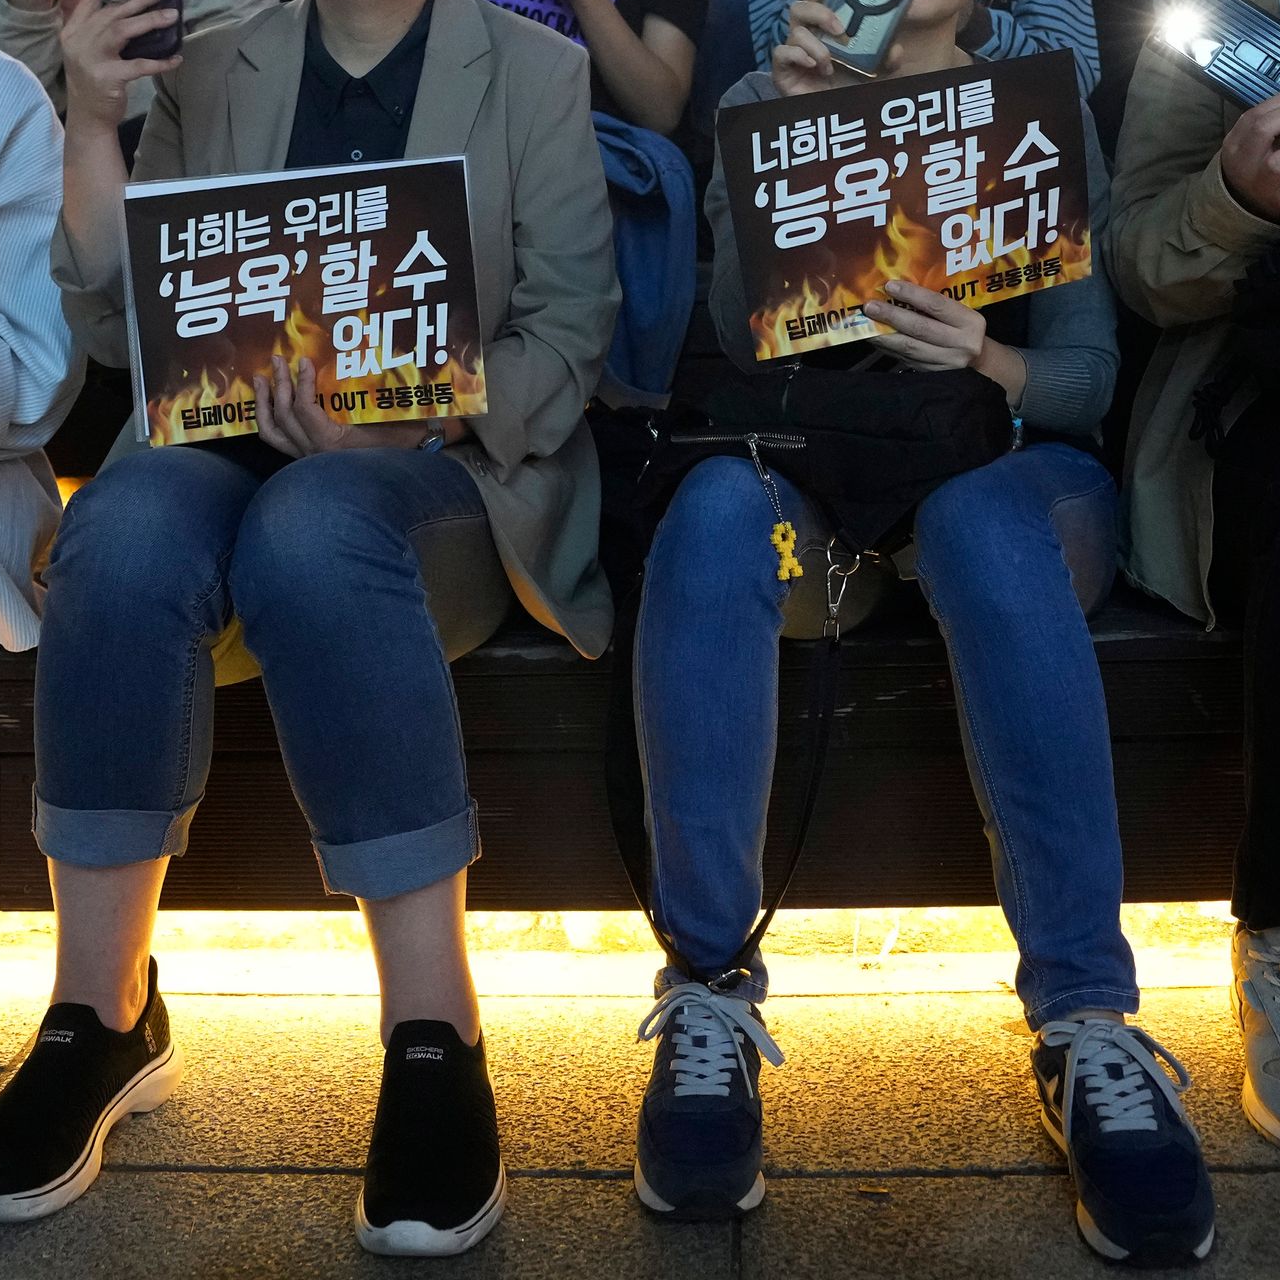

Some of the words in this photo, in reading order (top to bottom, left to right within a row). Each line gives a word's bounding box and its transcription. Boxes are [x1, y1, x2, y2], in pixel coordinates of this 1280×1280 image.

[752, 113, 866, 173] 너희는
[881, 78, 995, 145] 우리를
[1003, 120, 1060, 190] 수
[159, 209, 271, 264] 너희는
[283, 185, 389, 243] 우리를
[940, 183, 1060, 276] 없다!
[393, 229, 448, 301] 수
[940, 279, 977, 302] OUT
[986, 256, 1062, 292] 공동행동
[332, 303, 449, 381] 없다!
[331, 391, 369, 412] OUT
[375, 383, 455, 410] 공동행동
